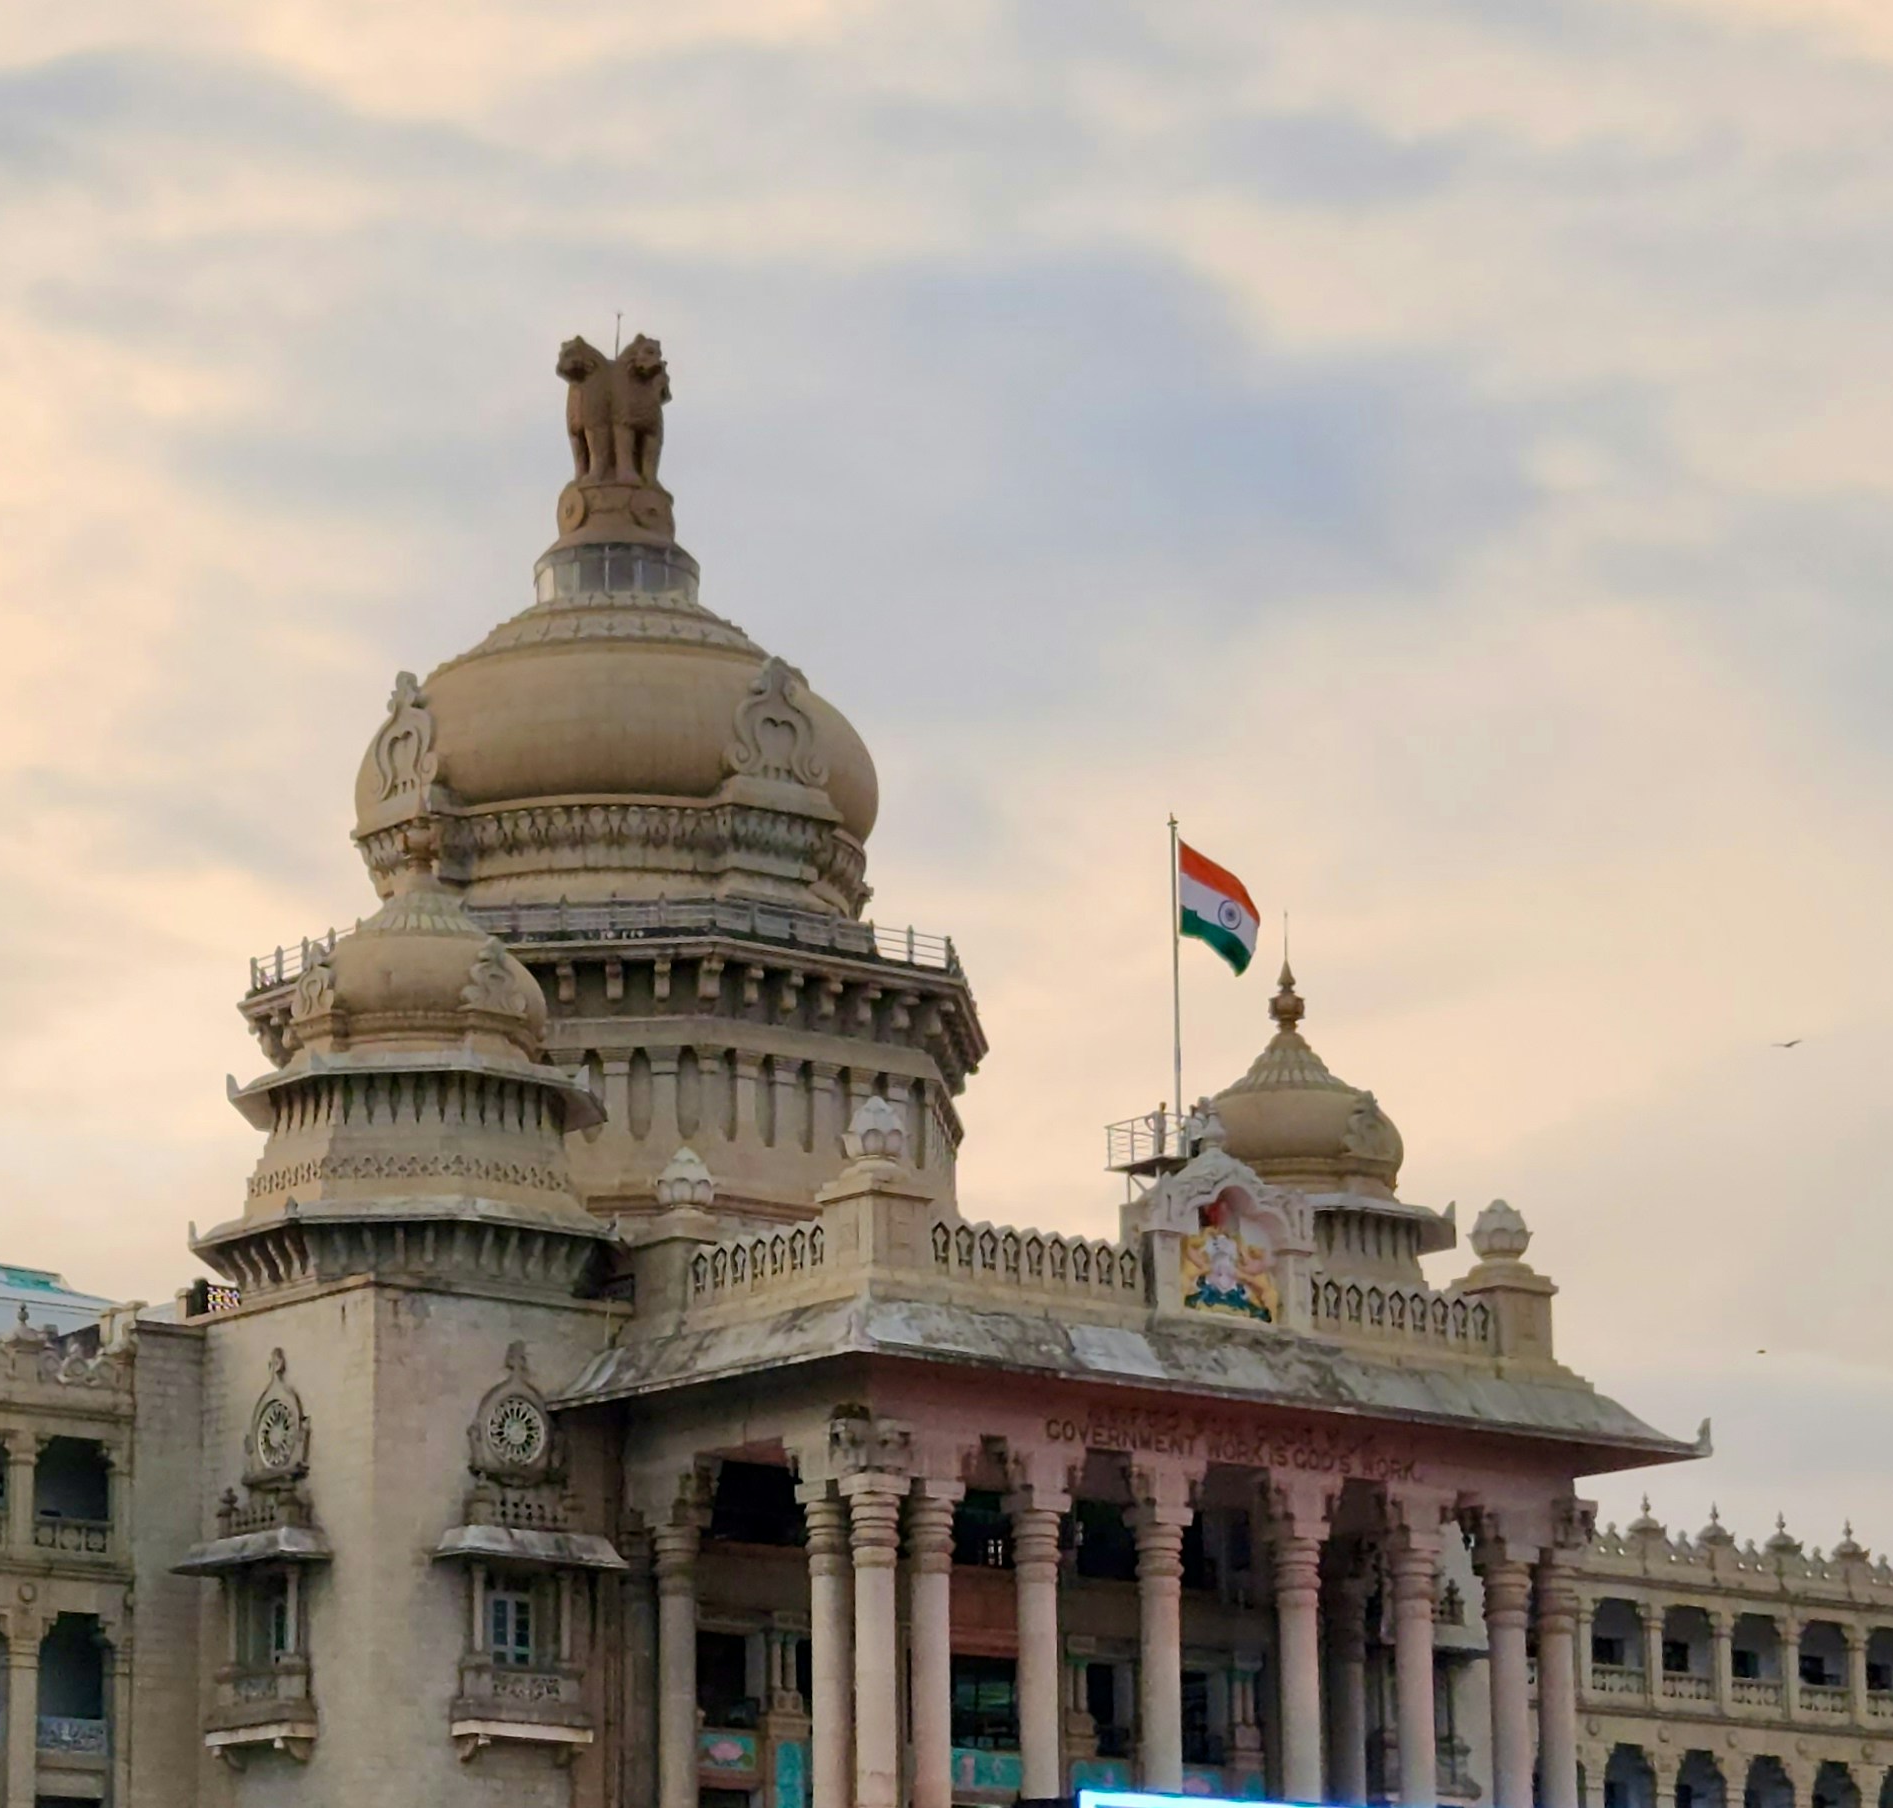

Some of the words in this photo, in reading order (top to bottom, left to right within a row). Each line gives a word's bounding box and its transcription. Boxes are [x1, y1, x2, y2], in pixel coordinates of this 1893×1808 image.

[1045, 1418, 1196, 1457] GOVERNMENT
[1208, 1438, 1263, 1463] WORK
[1269, 1447, 1288, 1467] IS
